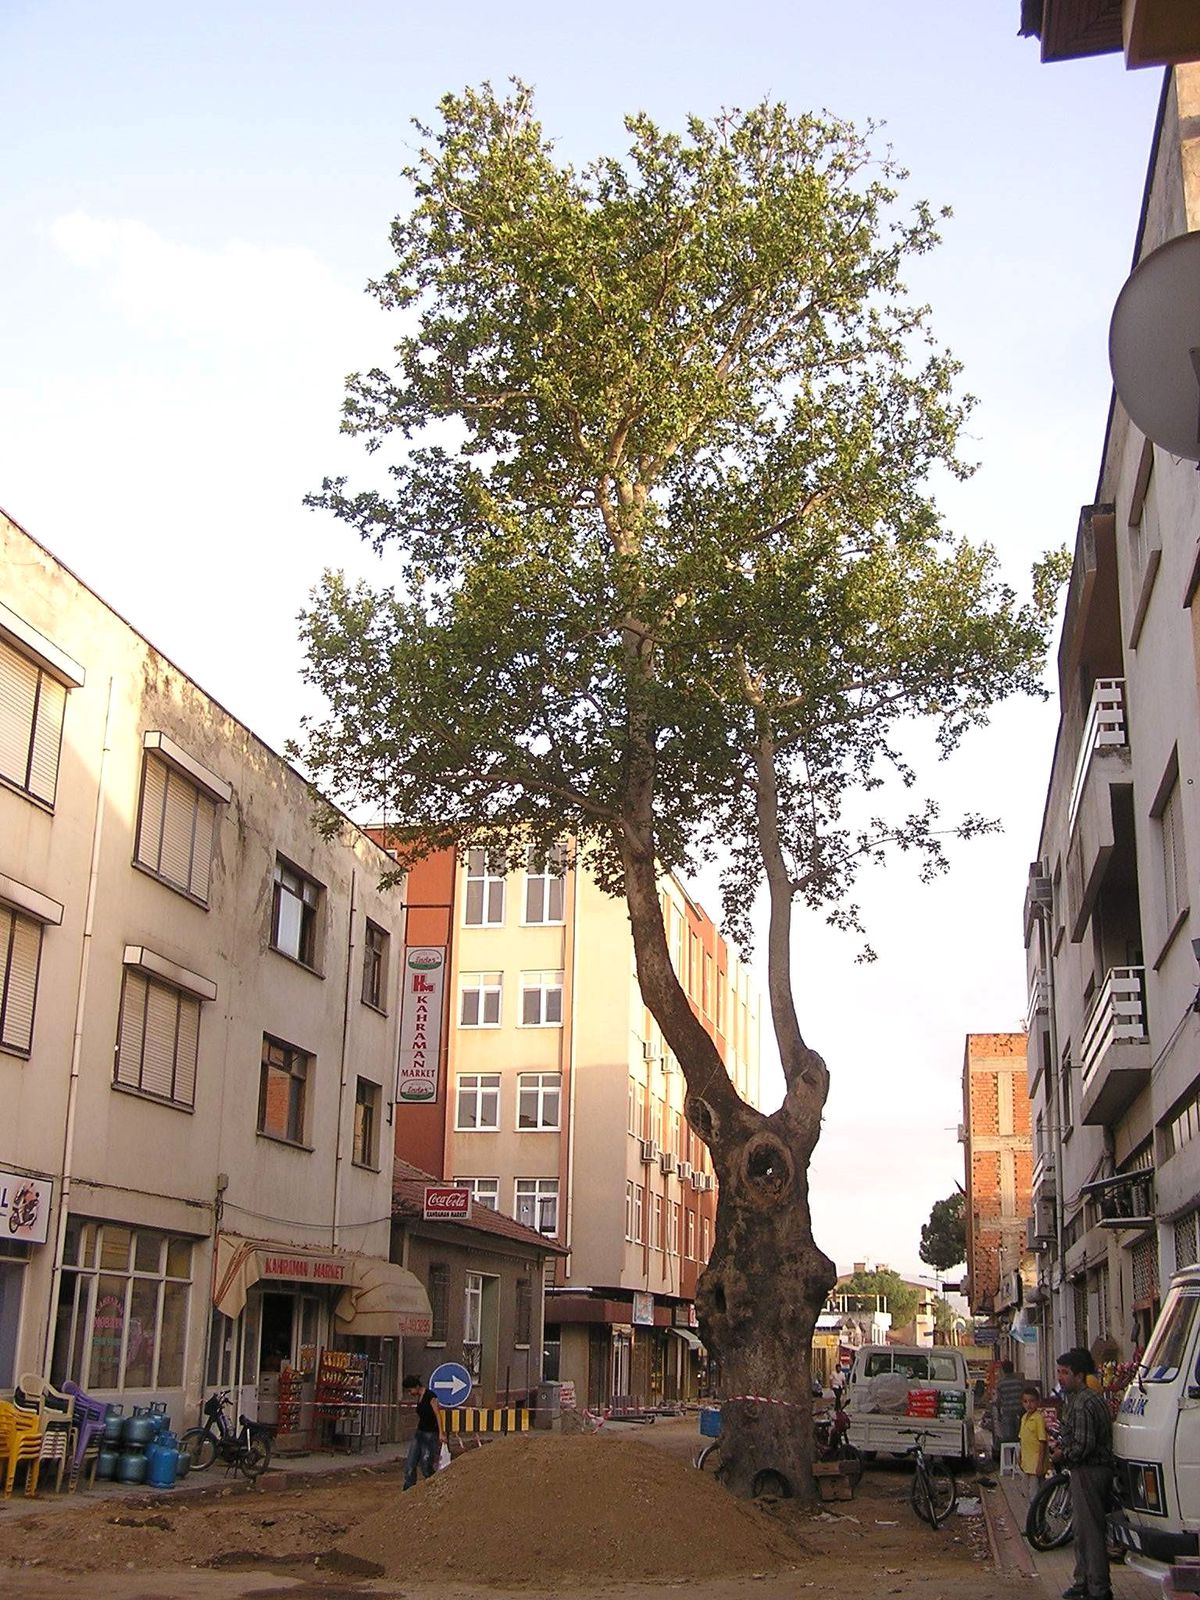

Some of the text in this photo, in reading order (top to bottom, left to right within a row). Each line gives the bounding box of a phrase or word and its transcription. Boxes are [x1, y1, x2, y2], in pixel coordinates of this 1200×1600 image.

[412, 995, 428, 1068] KAHRAMAN
[400, 1069, 436, 1078] MARKET
[264, 1257, 345, 1280] KAHRAMAN MARKET
